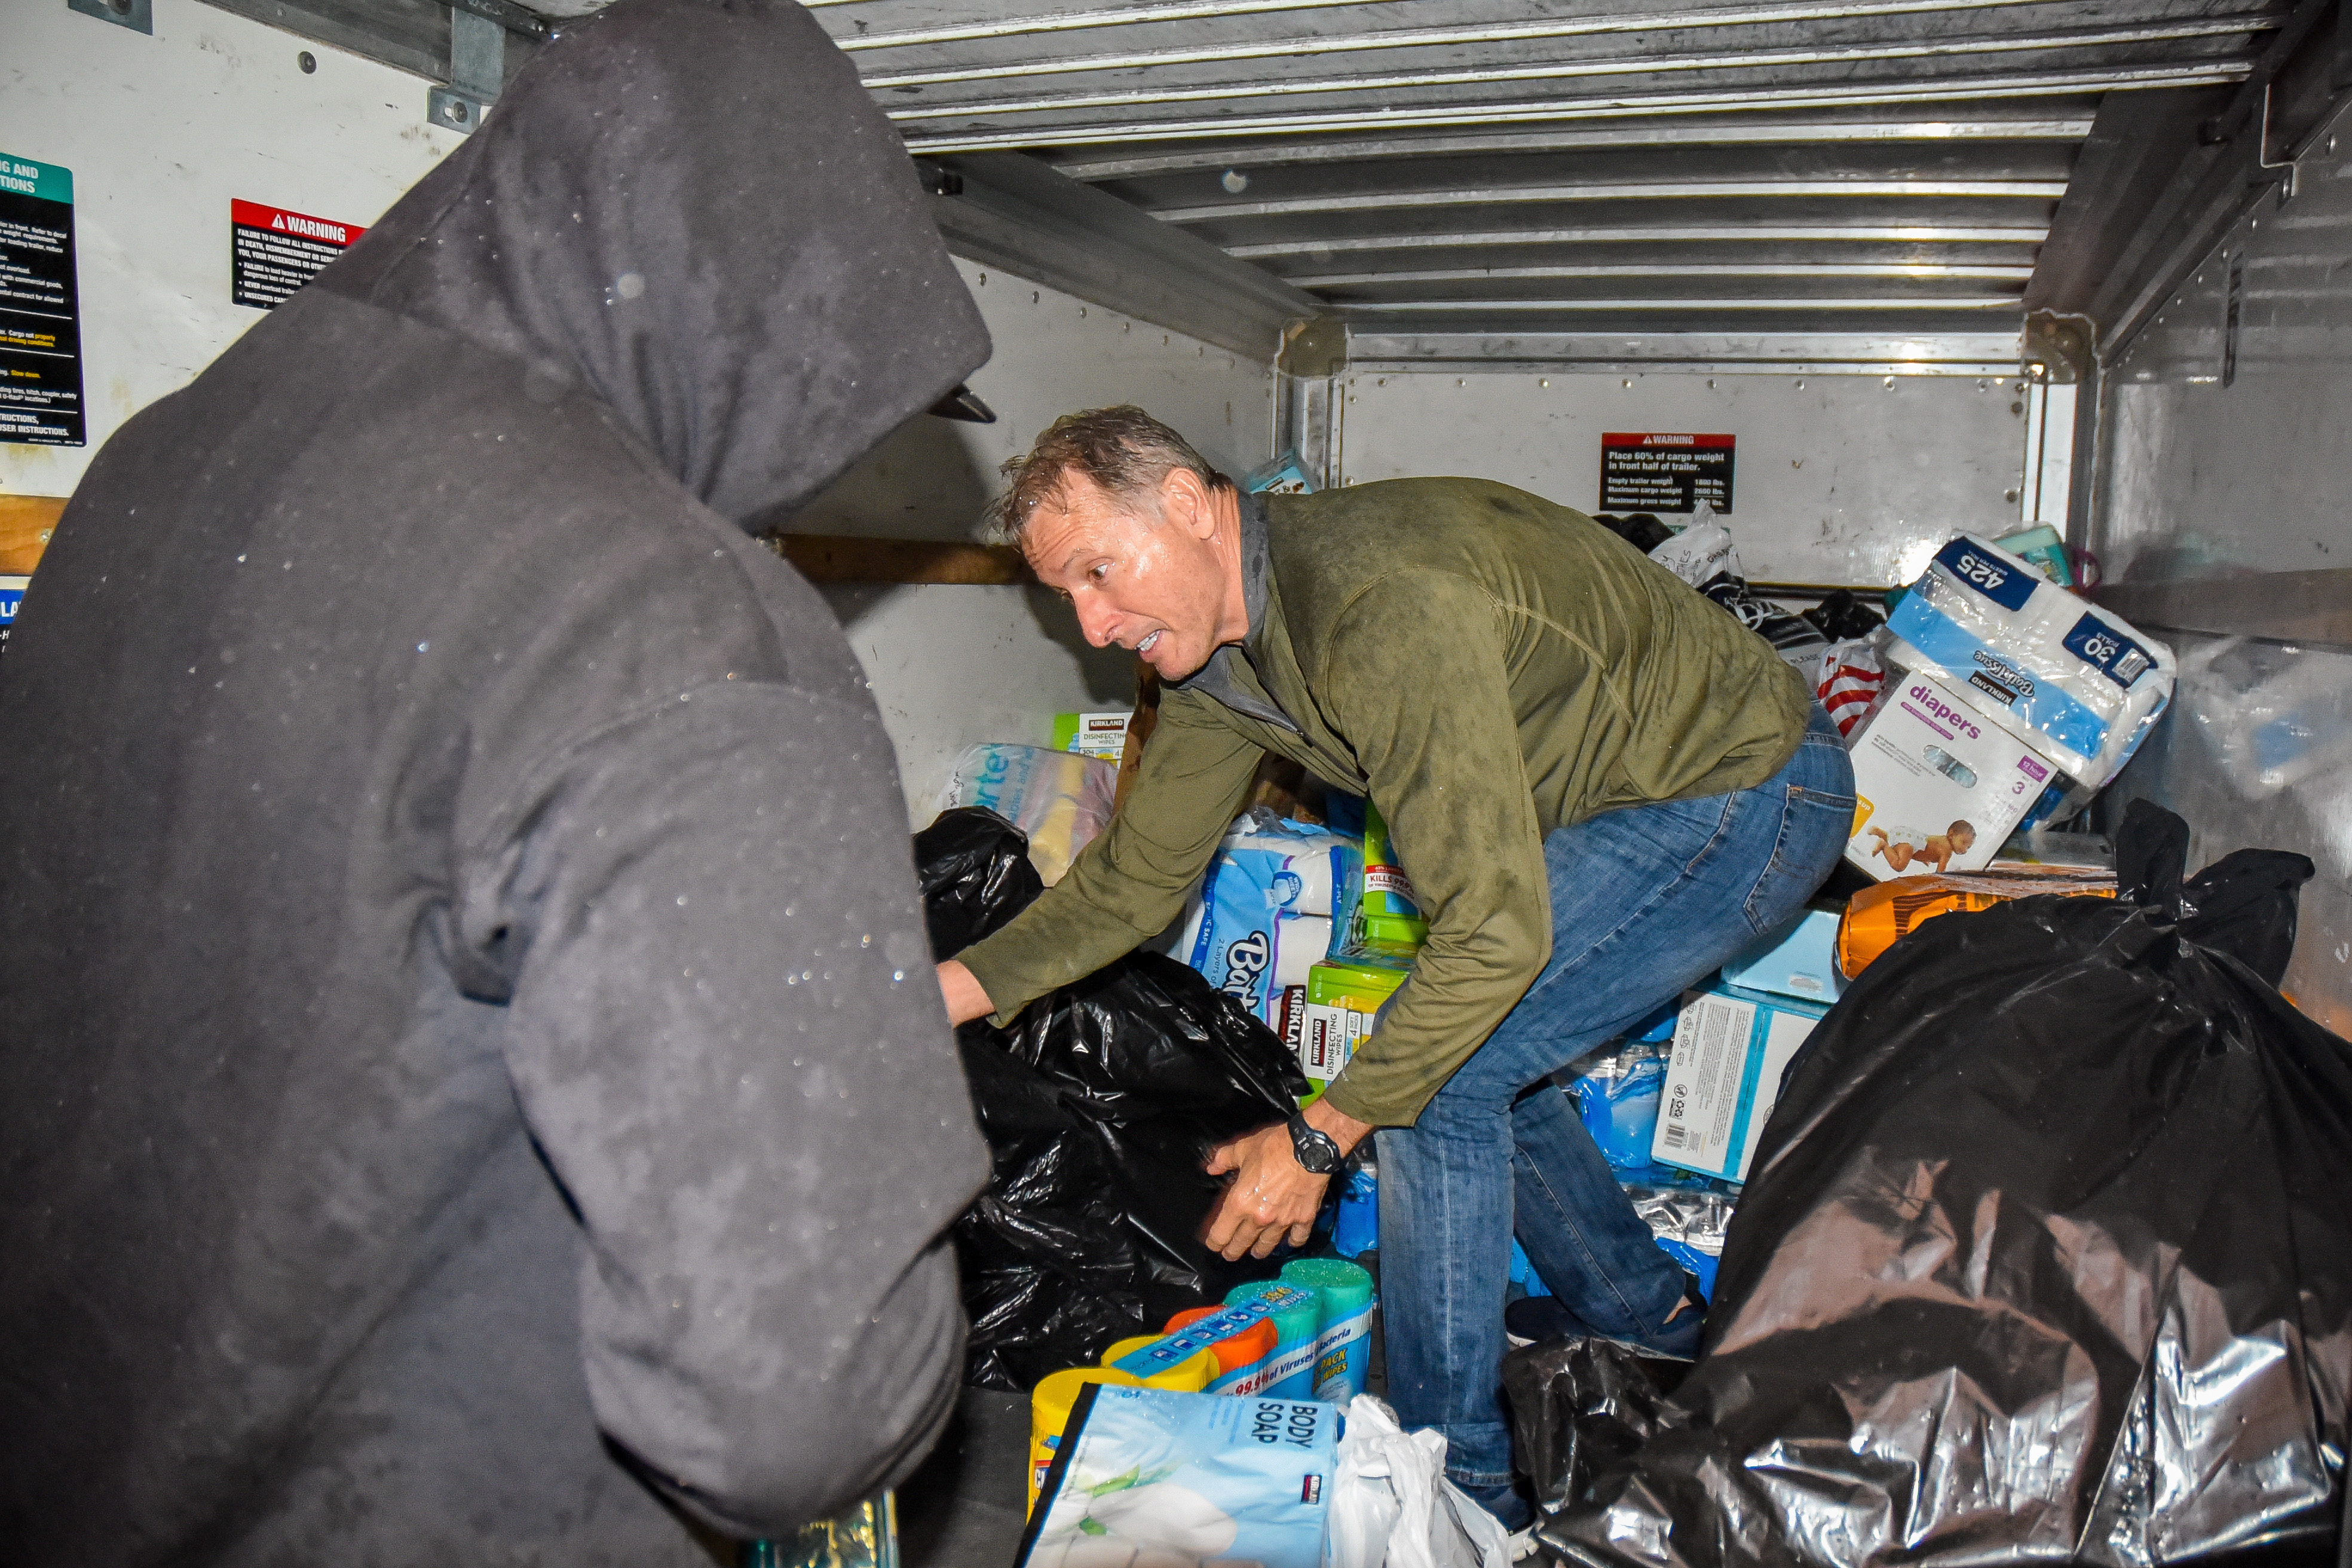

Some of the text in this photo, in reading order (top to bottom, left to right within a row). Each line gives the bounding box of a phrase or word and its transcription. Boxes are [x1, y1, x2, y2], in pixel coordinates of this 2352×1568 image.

[13, 163, 39, 179] AND
[287, 215, 346, 243] WARNING
[238, 228, 261, 240] FAILURE
[270, 235, 290, 246] FOLLOW
[292, 237, 301, 248] ALL
[302, 242, 338, 255] INSTRUCTIONS
[246, 240, 265, 251] DEATH,
[266, 244, 311, 259] DISMEMBERMENT
[312, 253, 320, 261] OR
[238, 249, 252, 259] YOU,
[252, 252, 267, 261] YOUR
[268, 255, 301, 267] PASSENGERS
[302, 261, 310, 270] OR
[8, 329, 24, 339] Cargo
[18, 425, 69, 436] INSTRUCTIONS.
[1653, 435, 1694, 445] WARNING
[1609, 452, 1633, 460] Place
[1656, 452, 1665, 460] of
[1667, 454, 1692, 463] cargo
[1694, 453, 1724, 463] weight
[1609, 461, 1701, 471] in front half of trailer.
[1609, 477, 1628, 485] Empty
[1651, 476, 1673, 486] weight
[1660, 497, 1681, 506] weight
[1956, 555, 2005, 590] 425
[2084, 638, 2116, 663] 30
[1973, 650, 2035, 698] Bath Tissue
[1971, 675, 2013, 705] KIRKLAND
[1910, 685, 1982, 740] diapers
[2011, 781, 2026, 795] 3
[1288, 876, 1296, 898] SHEETS
[1370, 875, 1392, 883] KILLS
[1335, 883, 1343, 905] 2-PLY
[1205, 901, 1214, 927] SEIC
[1200, 926, 1211, 947] SAFE
[1212, 945, 1224, 974] Layers
[1286, 988, 1304, 1051] KIRKLAN
[1312, 1020, 1322, 1064] KIRKLAND
[1327, 1013, 1338, 1075] DISINFECTING
[1235, 1372, 1269, 1396] 99.9%
[1269, 1367, 1279, 1380] of
[1281, 1352, 1314, 1376] Viruses
[1322, 1362, 1348, 1380] WIPES
[1251, 1402, 1285, 1444] SOAP
[1285, 1405, 1318, 1449] BODY
